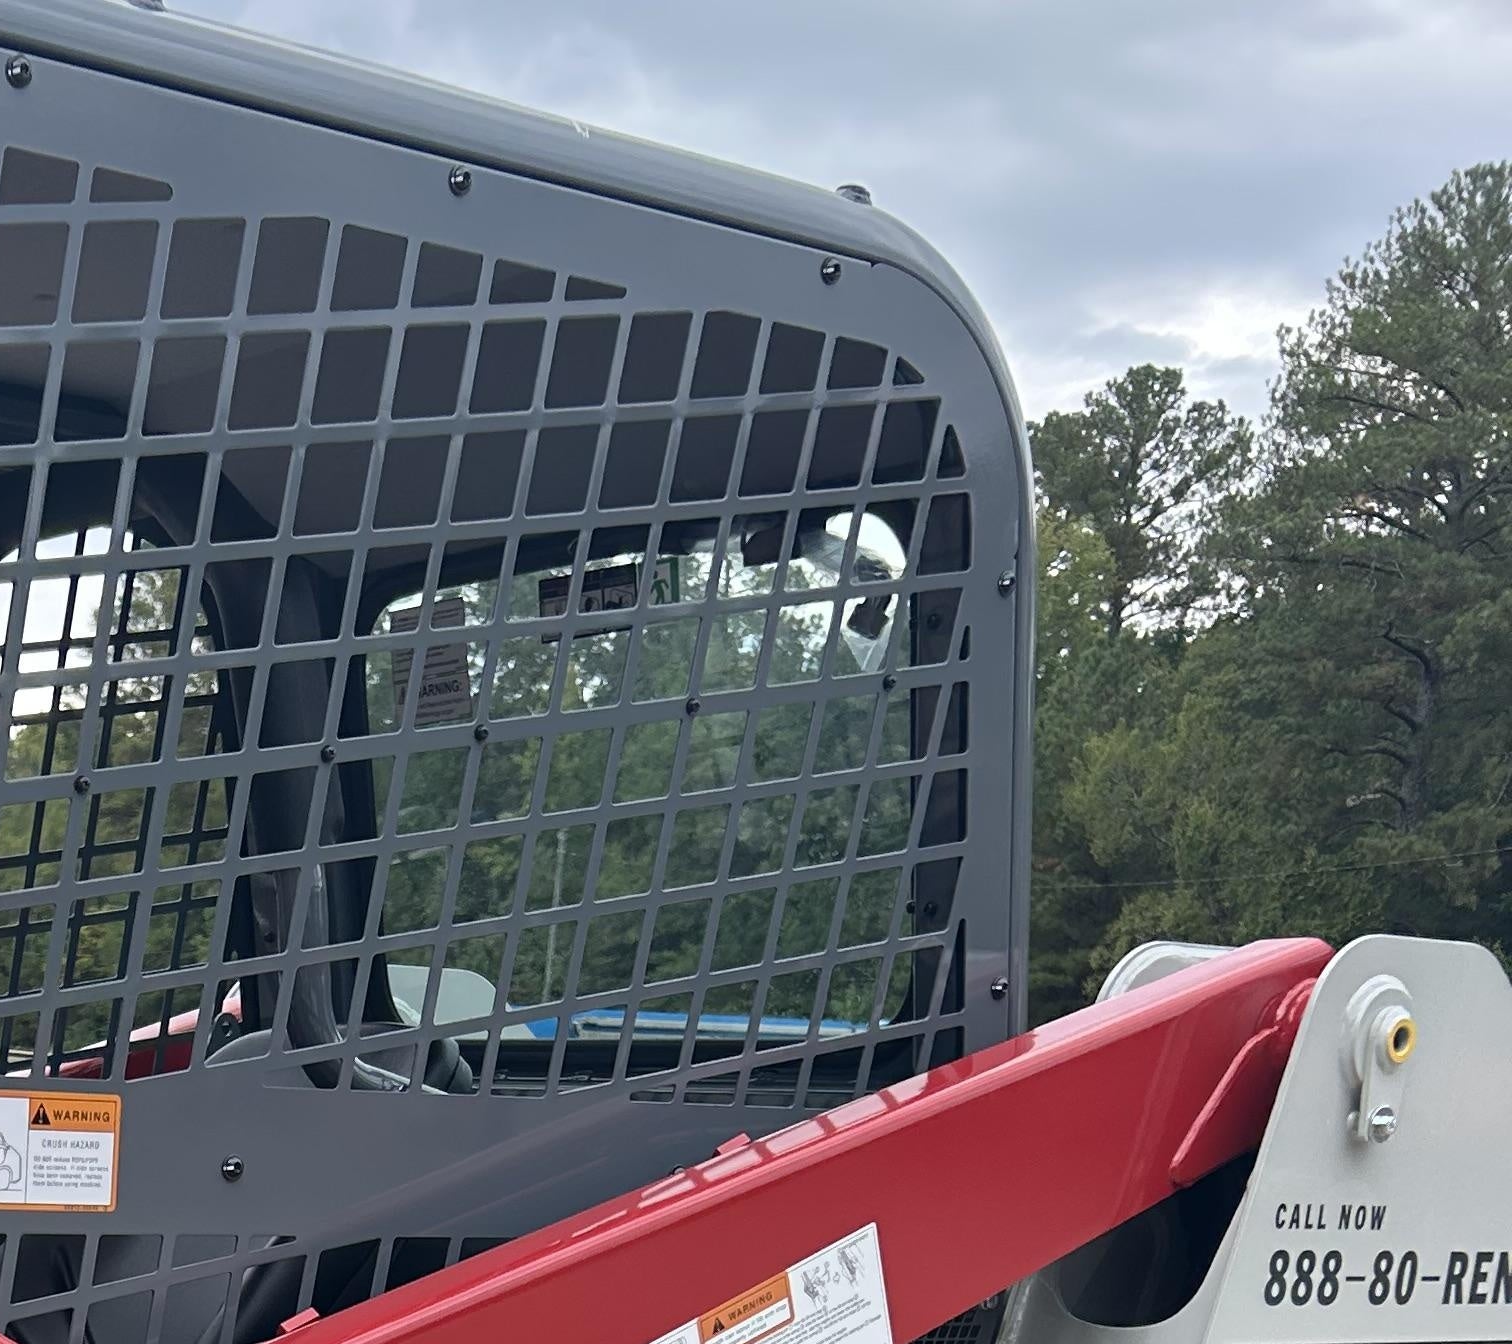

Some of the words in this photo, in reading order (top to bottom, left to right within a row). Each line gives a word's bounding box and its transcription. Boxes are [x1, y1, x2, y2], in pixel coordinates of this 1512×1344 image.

[53, 1109, 110, 1123] WARNING
[1274, 1203, 1328, 1232] CALL
[1337, 1203, 1387, 1232] NOW
[727, 1291, 773, 1321] WARNING
